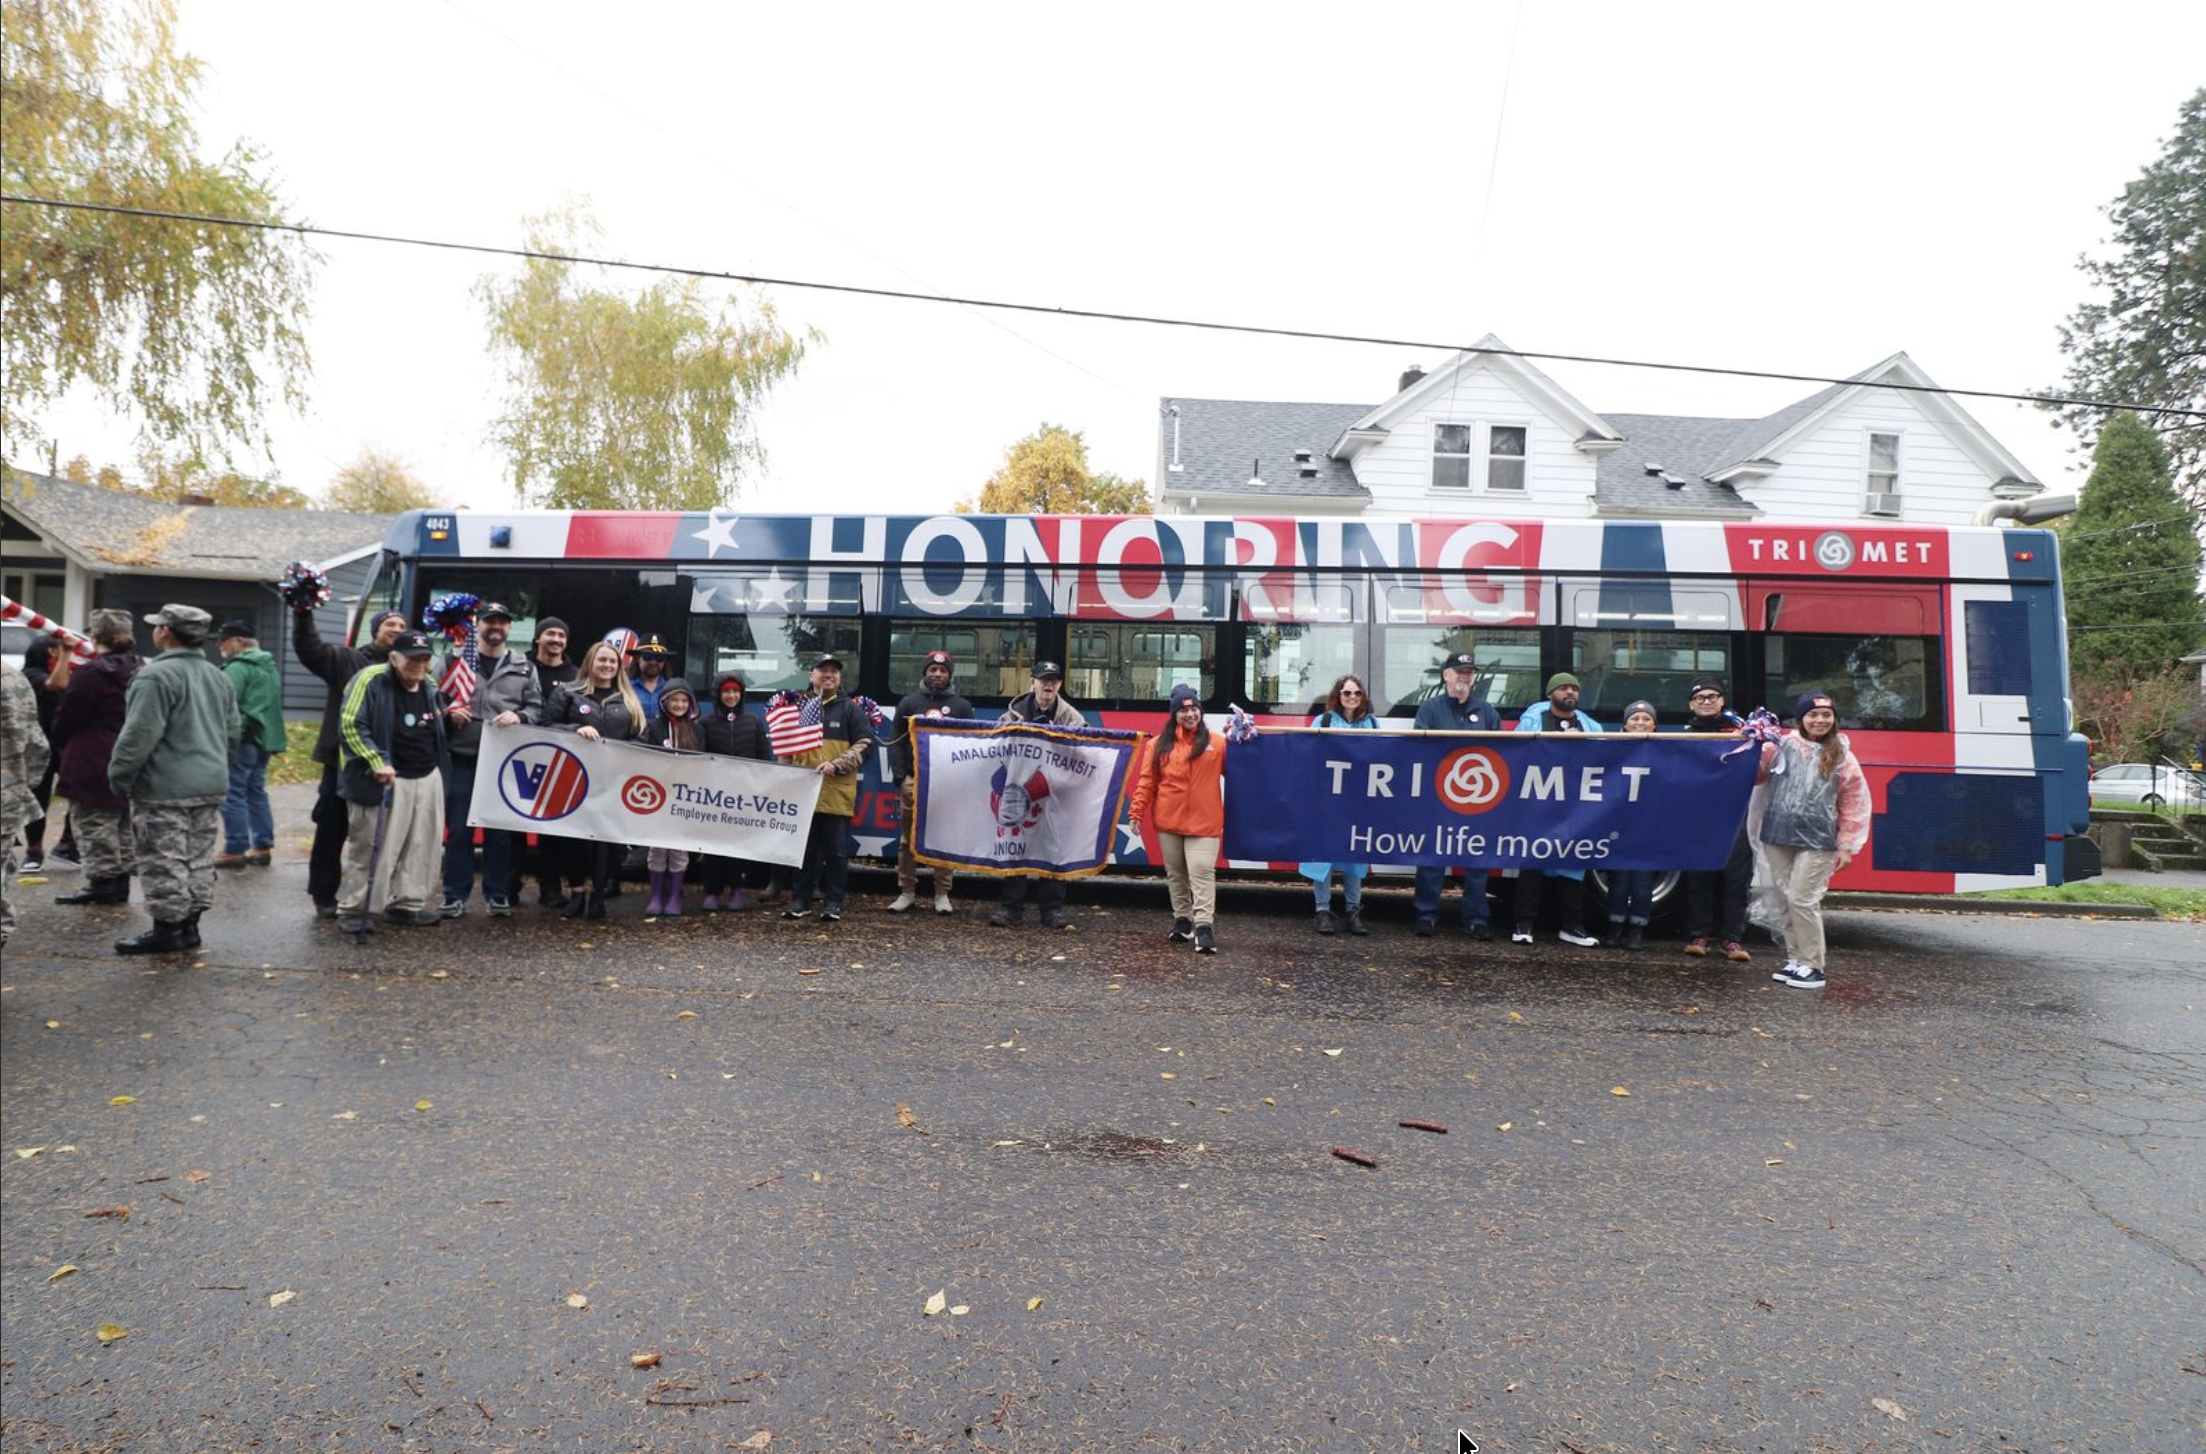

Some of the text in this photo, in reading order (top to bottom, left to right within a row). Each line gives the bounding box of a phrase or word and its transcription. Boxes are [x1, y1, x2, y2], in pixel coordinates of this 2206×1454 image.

[426, 517, 450, 530] 4043
[1748, 538, 1932, 563] TRI MET
[805, 515, 1528, 622] HONORING
[1045, 750, 1097, 778] TRANSIT
[1325, 759, 1650, 802] TRI MET
[672, 783, 798, 816] TriMet-Vets
[670, 803, 797, 835] Employee Resource Group
[1350, 824, 1425, 854] How
[1435, 825, 1486, 856] life
